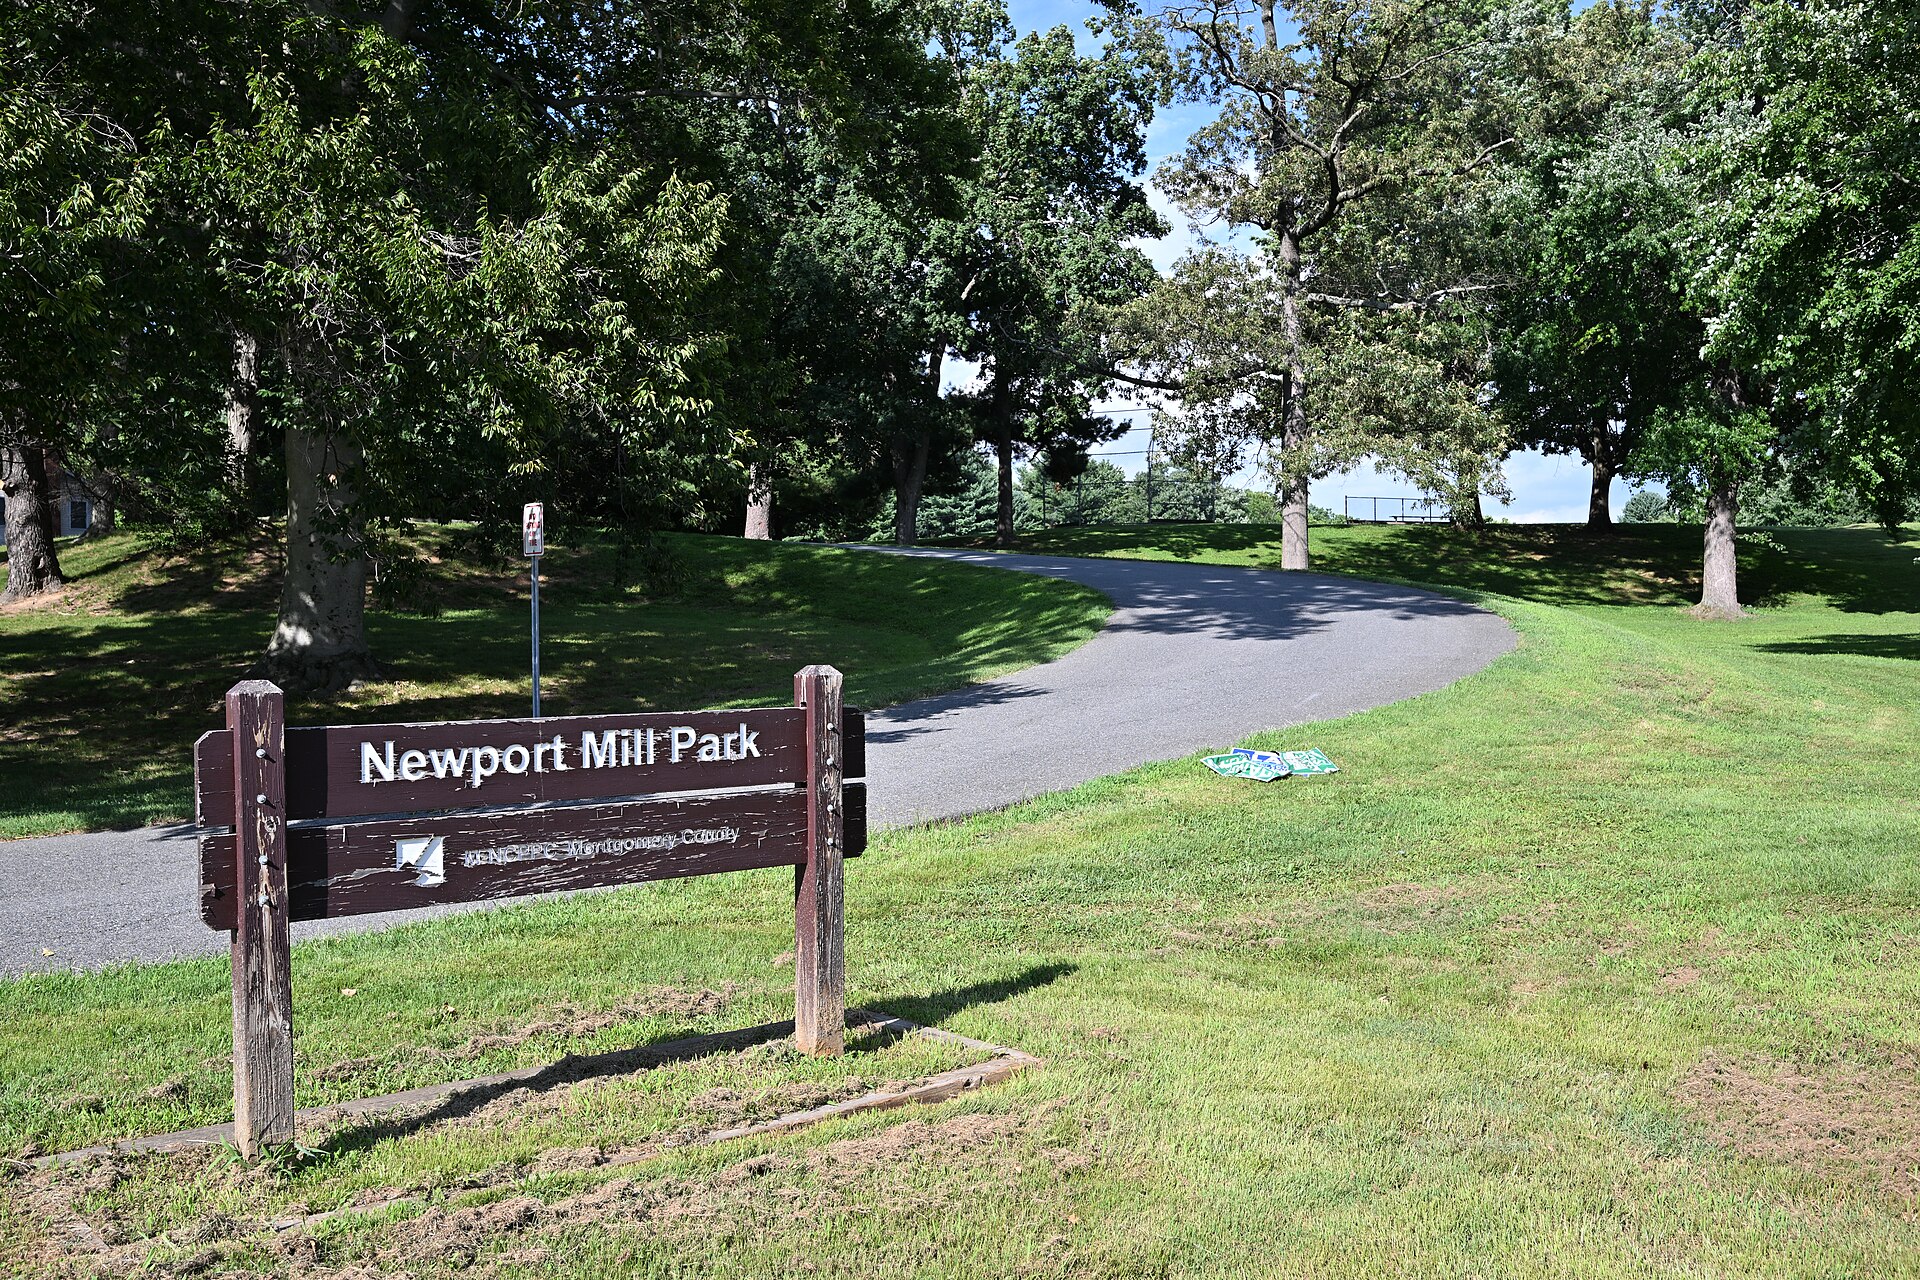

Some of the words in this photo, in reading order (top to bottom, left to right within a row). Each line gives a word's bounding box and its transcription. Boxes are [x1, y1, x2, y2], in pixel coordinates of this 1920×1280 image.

[361, 734, 568, 788] Newport
[582, 728, 654, 769] Mill
[671, 723, 760, 764] Park
[567, 832, 677, 856] Montgomery
[681, 826, 740, 845] County
